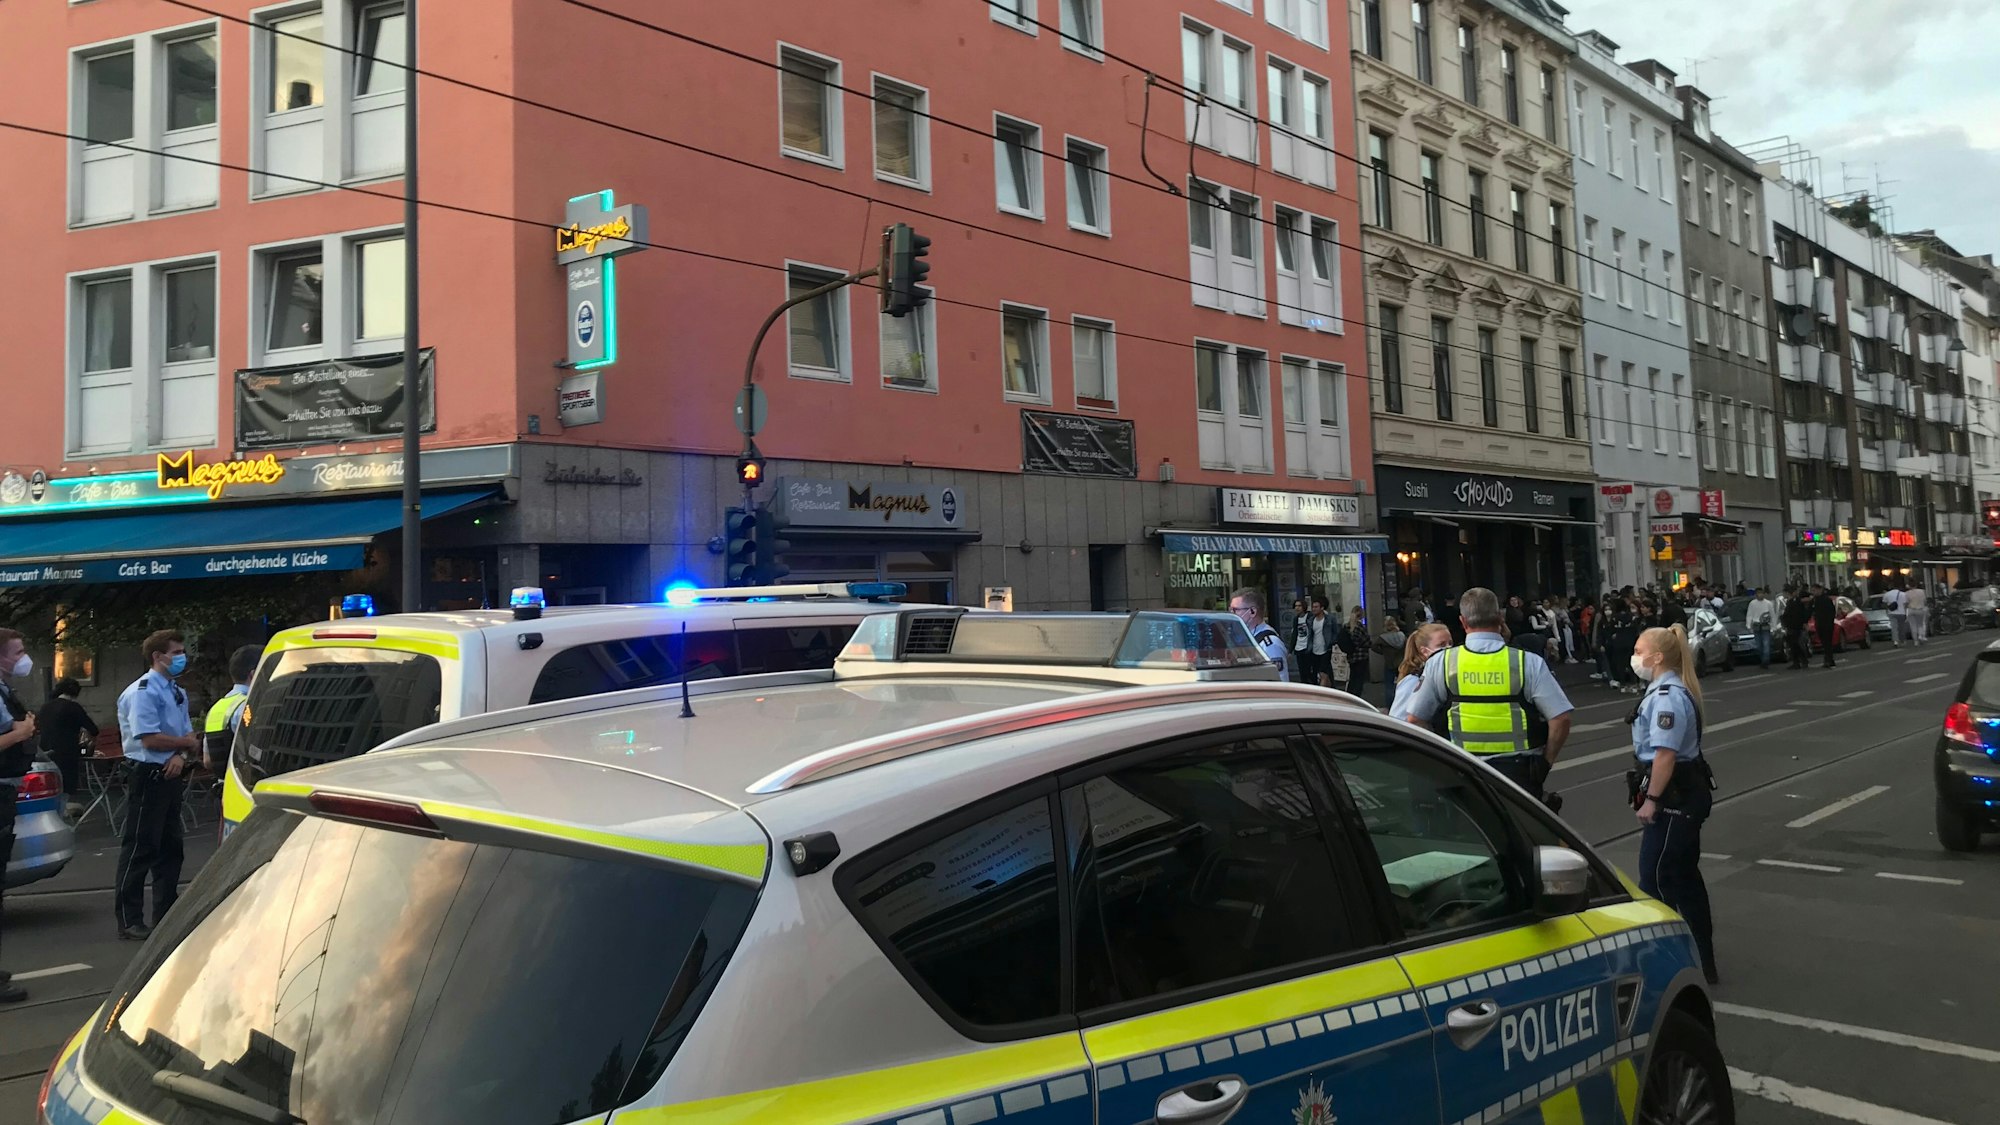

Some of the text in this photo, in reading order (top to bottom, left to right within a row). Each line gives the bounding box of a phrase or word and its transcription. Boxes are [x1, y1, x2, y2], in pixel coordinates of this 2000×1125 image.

[308, 368, 348, 385] Bestellung
[320, 406, 331, 419] Sie
[70, 482, 101, 504] Cafe
[110, 482, 138, 501] Bar
[157, 449, 285, 500] Magnus
[311, 458, 405, 486] Restaurant
[816, 484, 833, 497] Bar
[1405, 481, 1429, 498] Sushi
[1533, 491, 1555, 505] Ramen
[790, 498, 841, 512] Restaurant
[848, 482, 931, 522] Magnus
[1230, 492, 1357, 514] FALAFEL DAMASKUS
[1651, 523, 1680, 532] KIOSK
[1191, 536, 1372, 553] SHAWARMA FALAFEL DAMASKUS
[43, 566, 84, 584] Magnus
[118, 563, 148, 577] Cafe
[151, 561, 172, 575] Bar
[206, 554, 288, 574] durchgehende
[291, 552, 328, 567] Küche
[1169, 553, 1229, 574] FALAFEL
[1309, 554, 1357, 571] FALAFEL
[1170, 573, 1230, 588] SHAWARMA
[1462, 671, 1505, 685] POLIZEI
[1501, 986, 1599, 1072] POLIZEI
